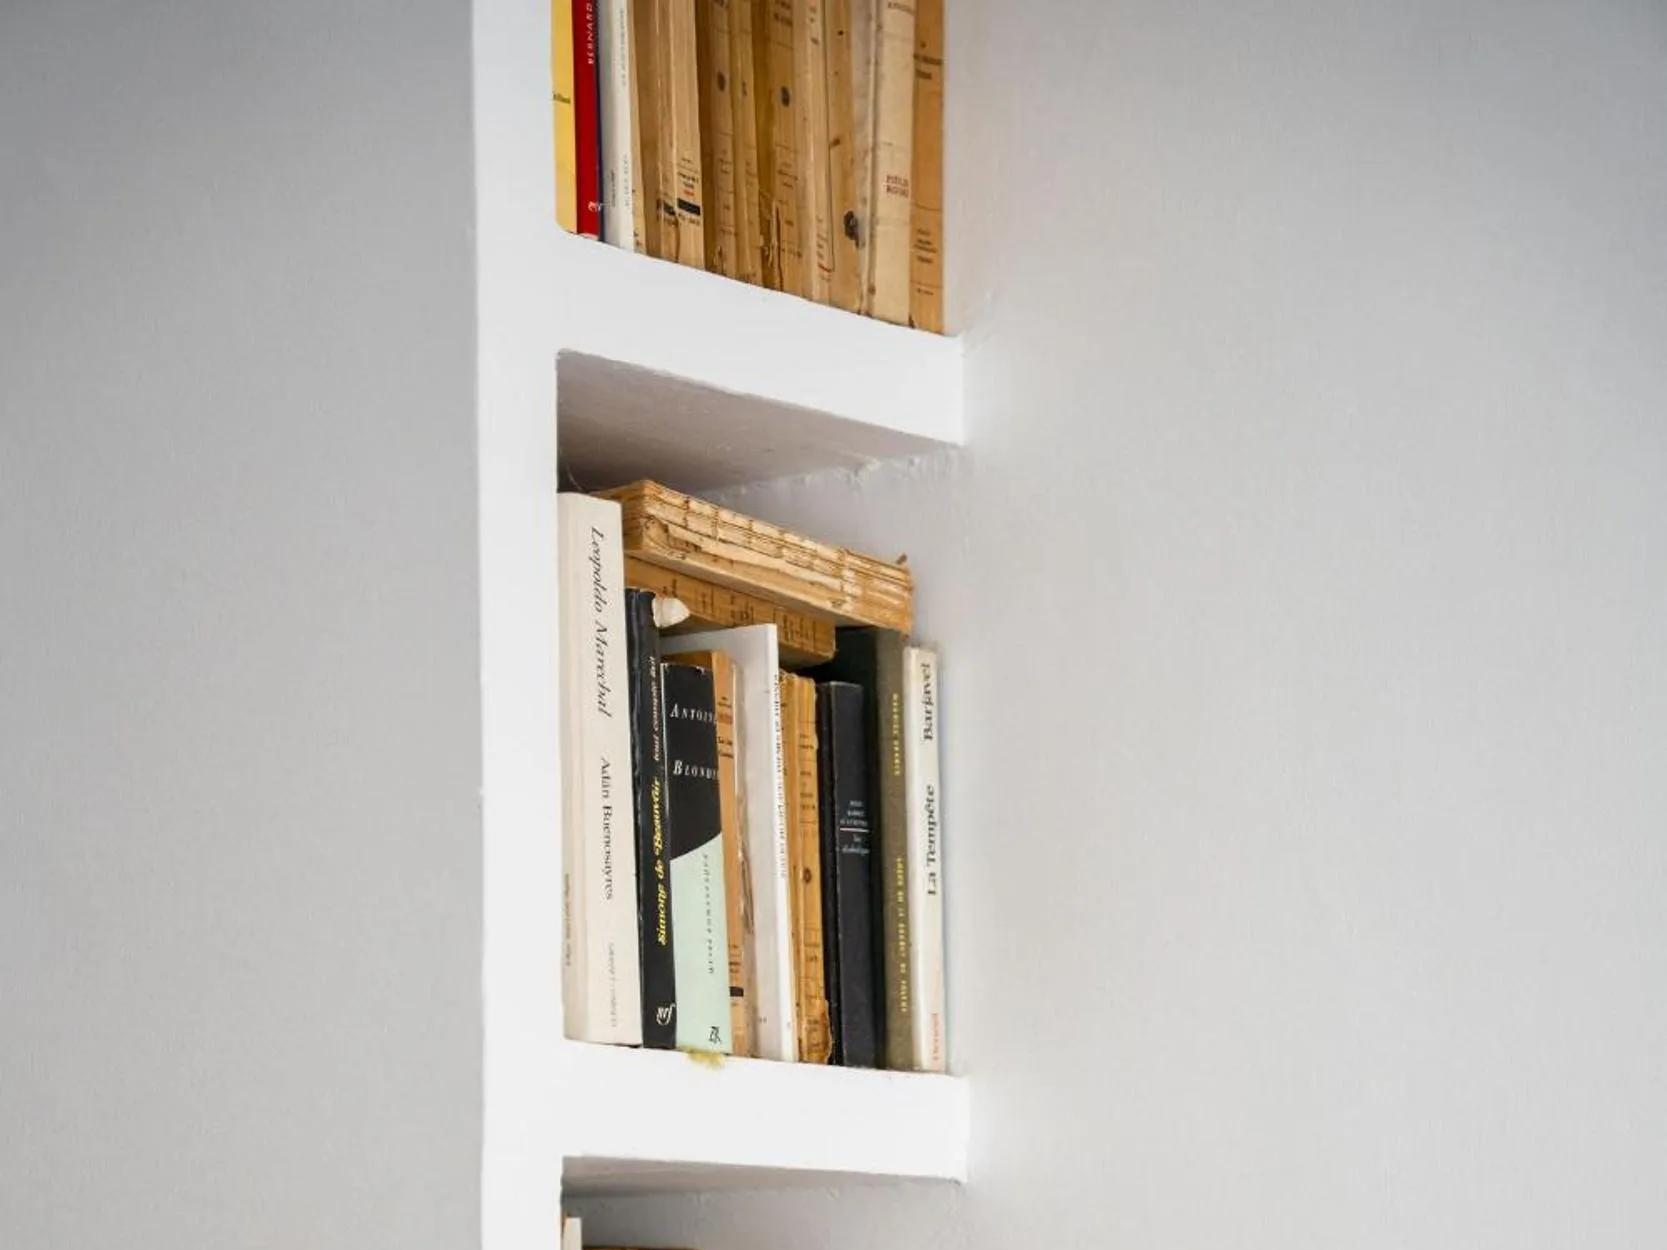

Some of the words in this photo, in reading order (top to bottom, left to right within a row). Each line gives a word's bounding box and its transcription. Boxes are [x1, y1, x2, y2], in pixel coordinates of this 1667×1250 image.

[588, 526, 608, 614] Leopoldo
[595, 619, 613, 718] Marechal
[670, 703, 717, 724] ANTOIN
[920, 662, 934, 741] Barjavel
[600, 757, 613, 799] Adán
[673, 759, 716, 779] BLONDI
[602, 805, 615, 902] Buenosayres
[924, 784, 937, 867] Tempête
[654, 859, 664, 880] de
[926, 872, 936, 896] La
[656, 883, 667, 946] Simone
